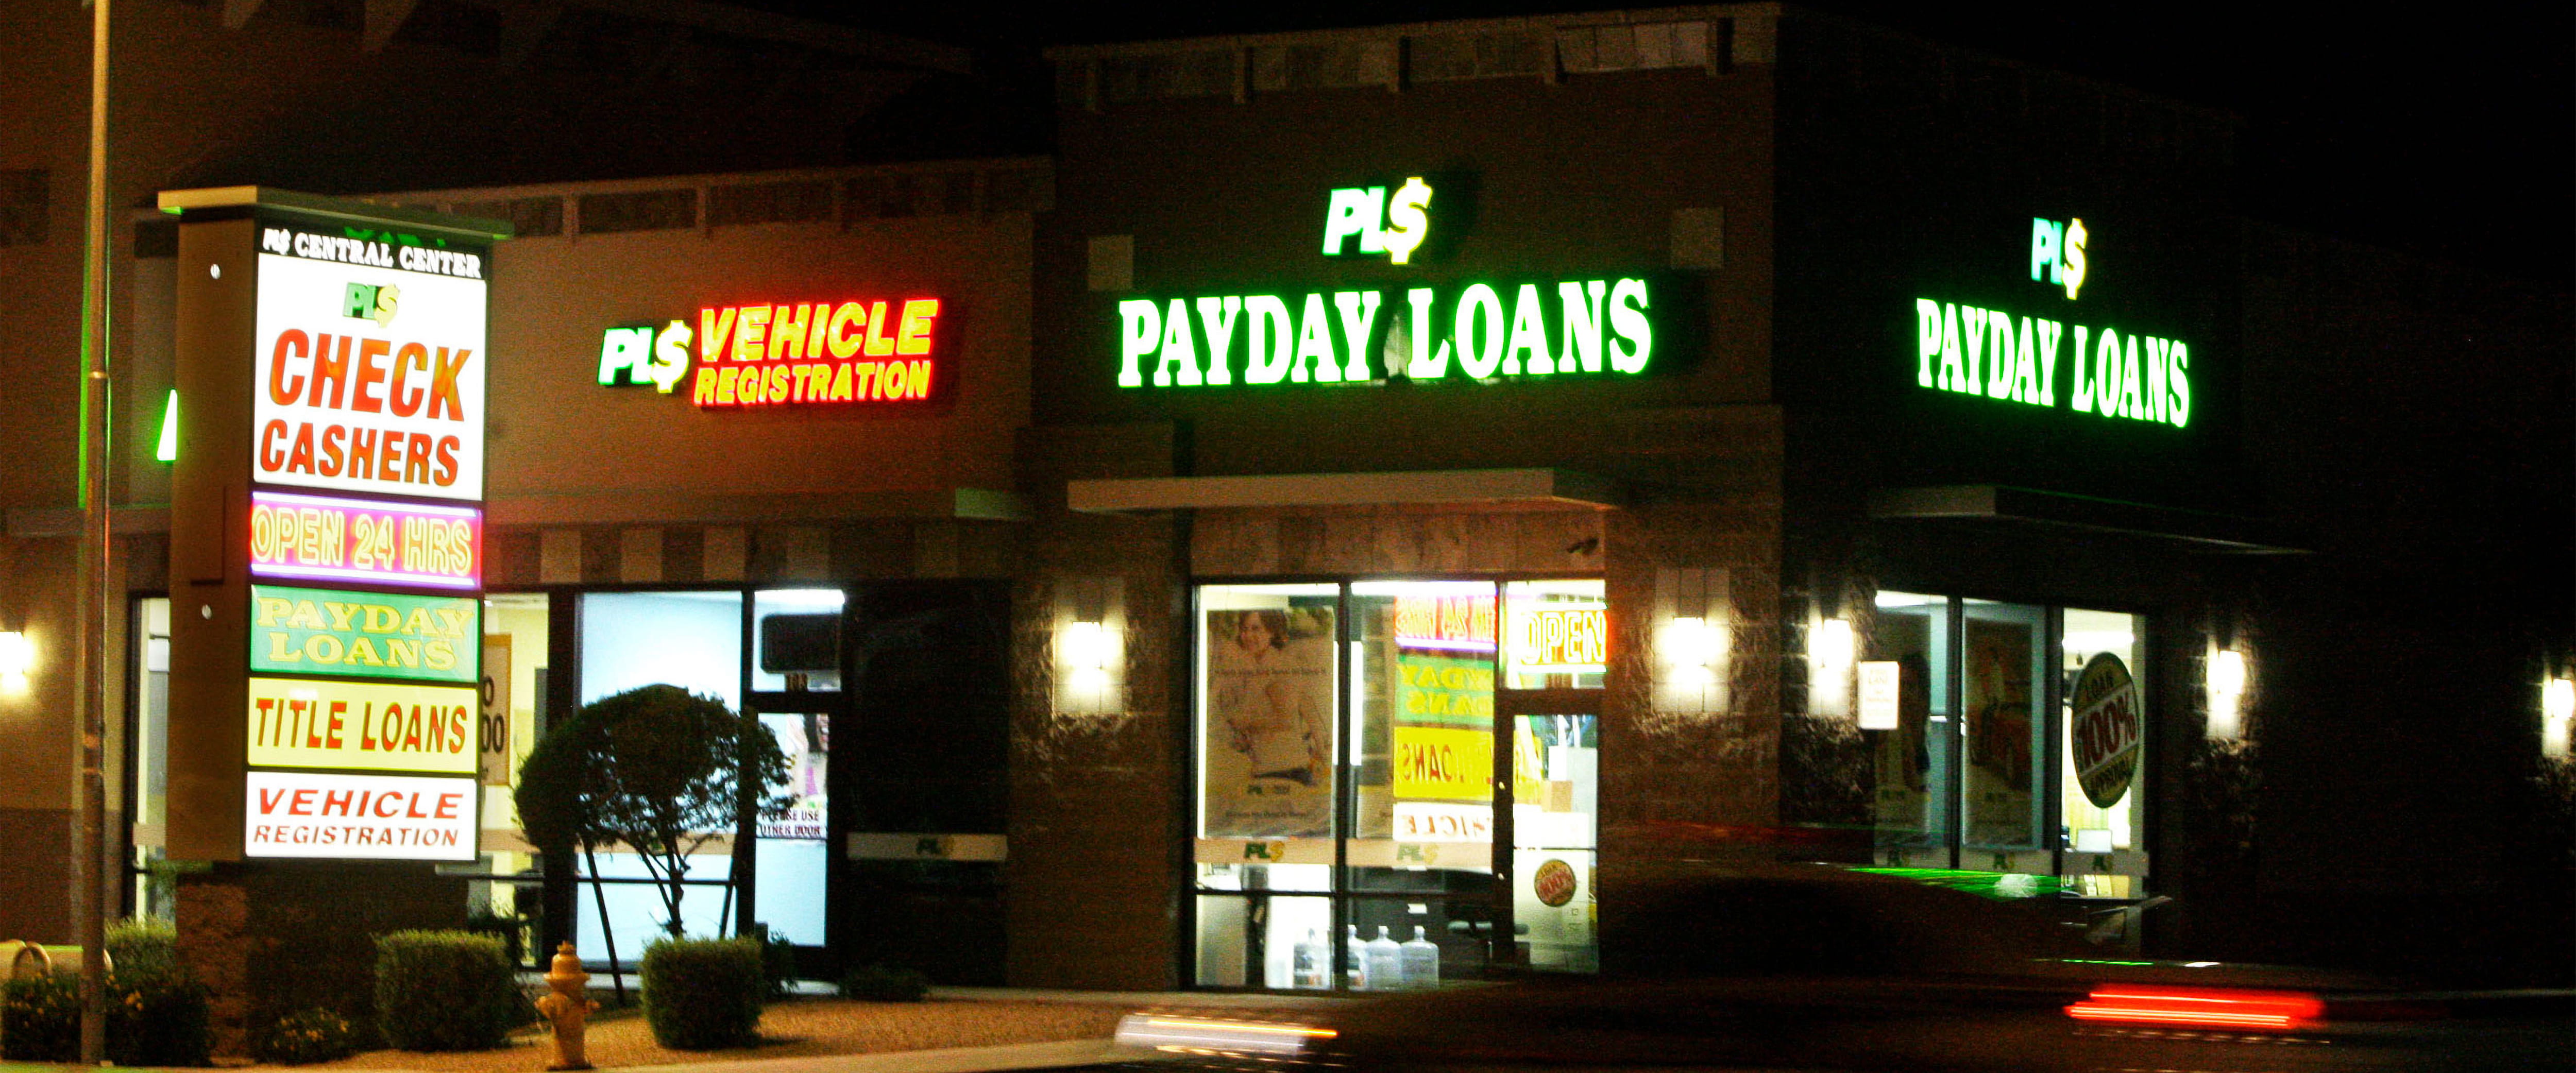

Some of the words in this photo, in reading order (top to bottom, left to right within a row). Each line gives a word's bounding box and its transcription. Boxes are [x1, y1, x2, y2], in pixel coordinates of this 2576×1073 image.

[294, 232, 394, 268] CENTRAL
[399, 246, 482, 279] CENTER
[700, 299, 939, 363] VEHICLE
[1118, 291, 1381, 387] PAYDAY
[1406, 278, 1652, 378] LOANS
[269, 328, 472, 422] CHECK
[693, 361, 932, 405] REGISTRATION
[1917, 298, 2061, 407] PAYDAY
[2072, 325, 2190, 428] LOANS
[260, 419, 460, 486] CASHERS
[251, 504, 346, 567] OPEN
[353, 514, 395, 571] 24
[403, 516, 472, 576] HRS
[257, 597, 474, 639] PAYDAY
[1518, 610, 1606, 665] OPEN
[269, 632, 456, 671] LOANS
[256, 697, 348, 750] TITLE
[361, 701, 467, 754] LOANS
[2076, 691, 2137, 769] 100%
[259, 788, 463, 820] VEHICLE
[801, 809, 819, 822] USE
[253, 825, 459, 847] REGISTRATION
